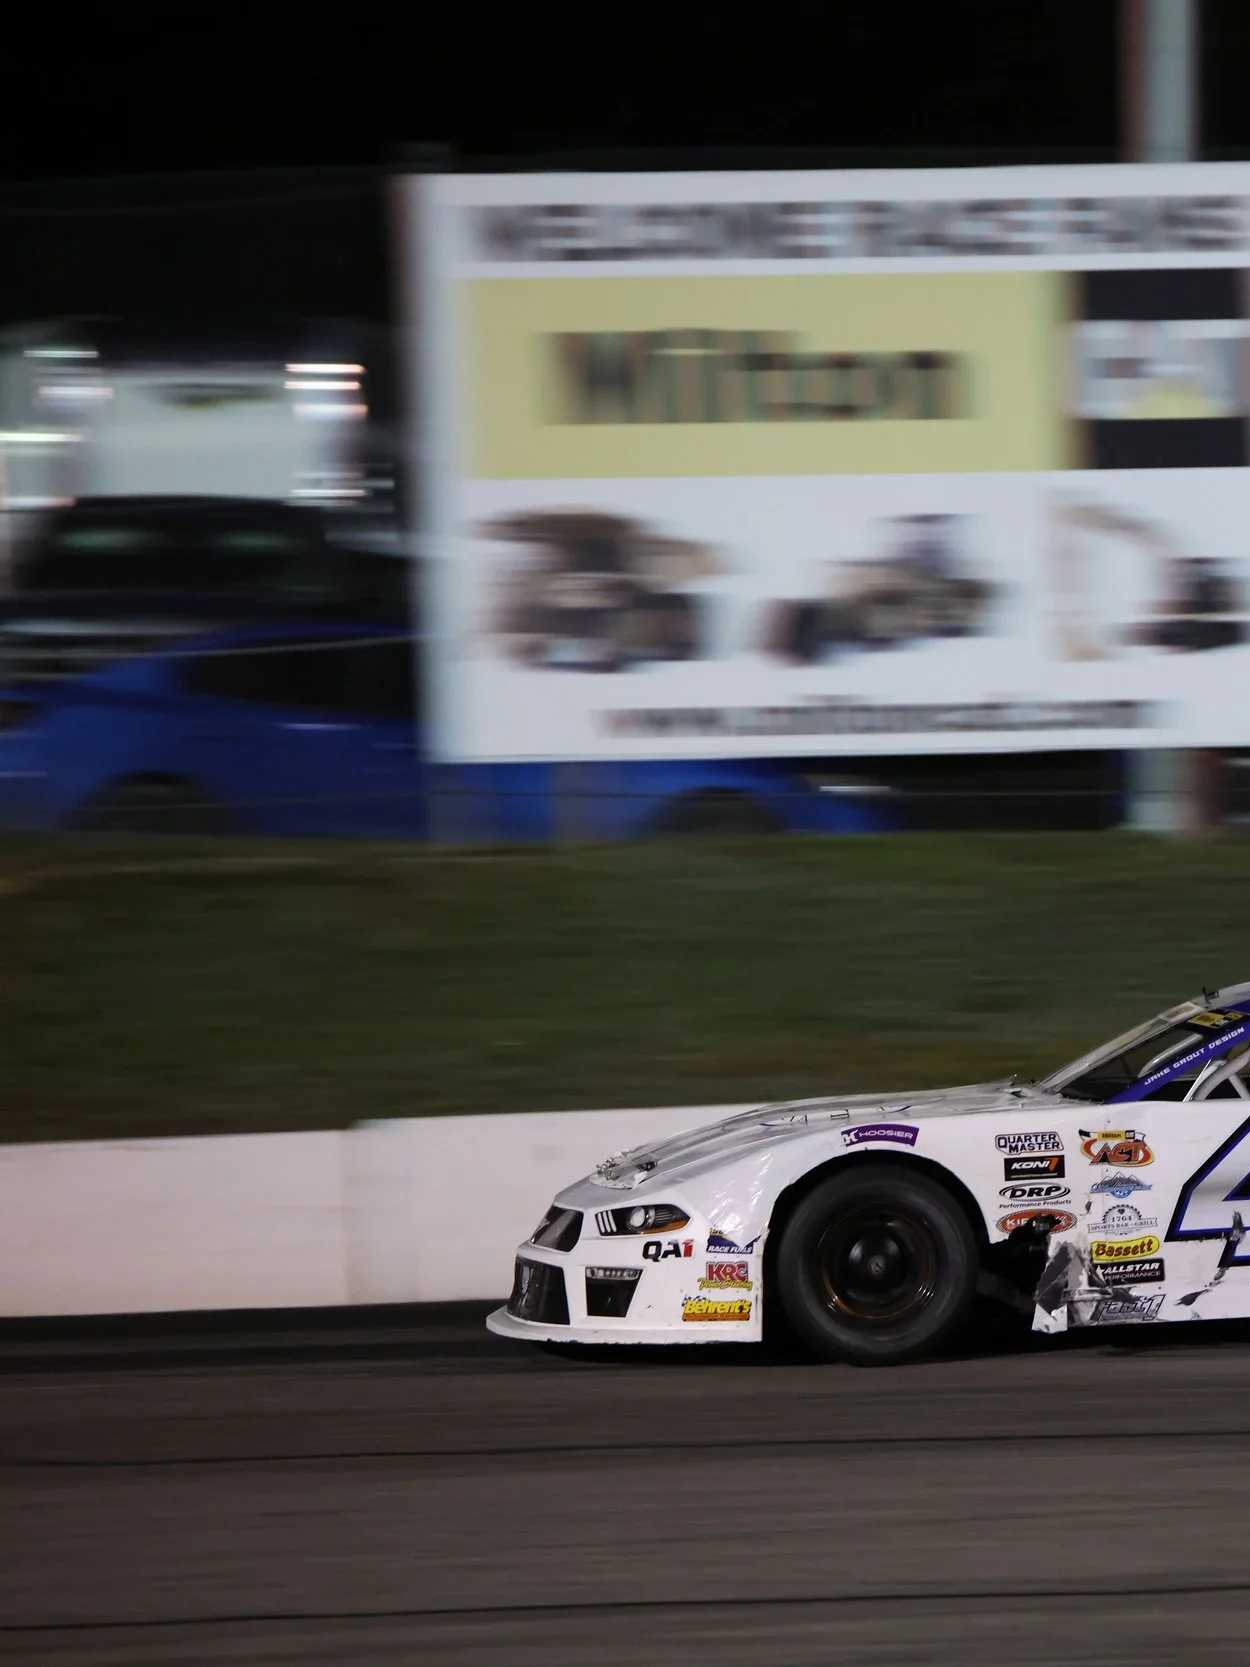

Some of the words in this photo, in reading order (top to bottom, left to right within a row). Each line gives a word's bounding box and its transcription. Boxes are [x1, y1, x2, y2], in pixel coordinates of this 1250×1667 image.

[1145, 1067, 1170, 1085] JAKE
[1173, 1048, 1205, 1069] GROUT
[1209, 1027, 1244, 1049] DESIGN
[859, 1130, 913, 1139] HOOSIER
[998, 1133, 1057, 1149] QUARTER
[1009, 1142, 1060, 1153] MASTER
[1011, 1160, 1050, 1170] KONI
[1009, 1185, 1061, 1199] DRP
[642, 1239, 694, 1262] QA1
[708, 1245, 729, 1253] RACE
[1094, 1238, 1153, 1257] Bassett
[706, 1262, 748, 1281] KRC
[1104, 1262, 1160, 1274] ALLSTAR
[1105, 1270, 1160, 1281] PERFORMANCE
[684, 1300, 752, 1314] Behrent's
